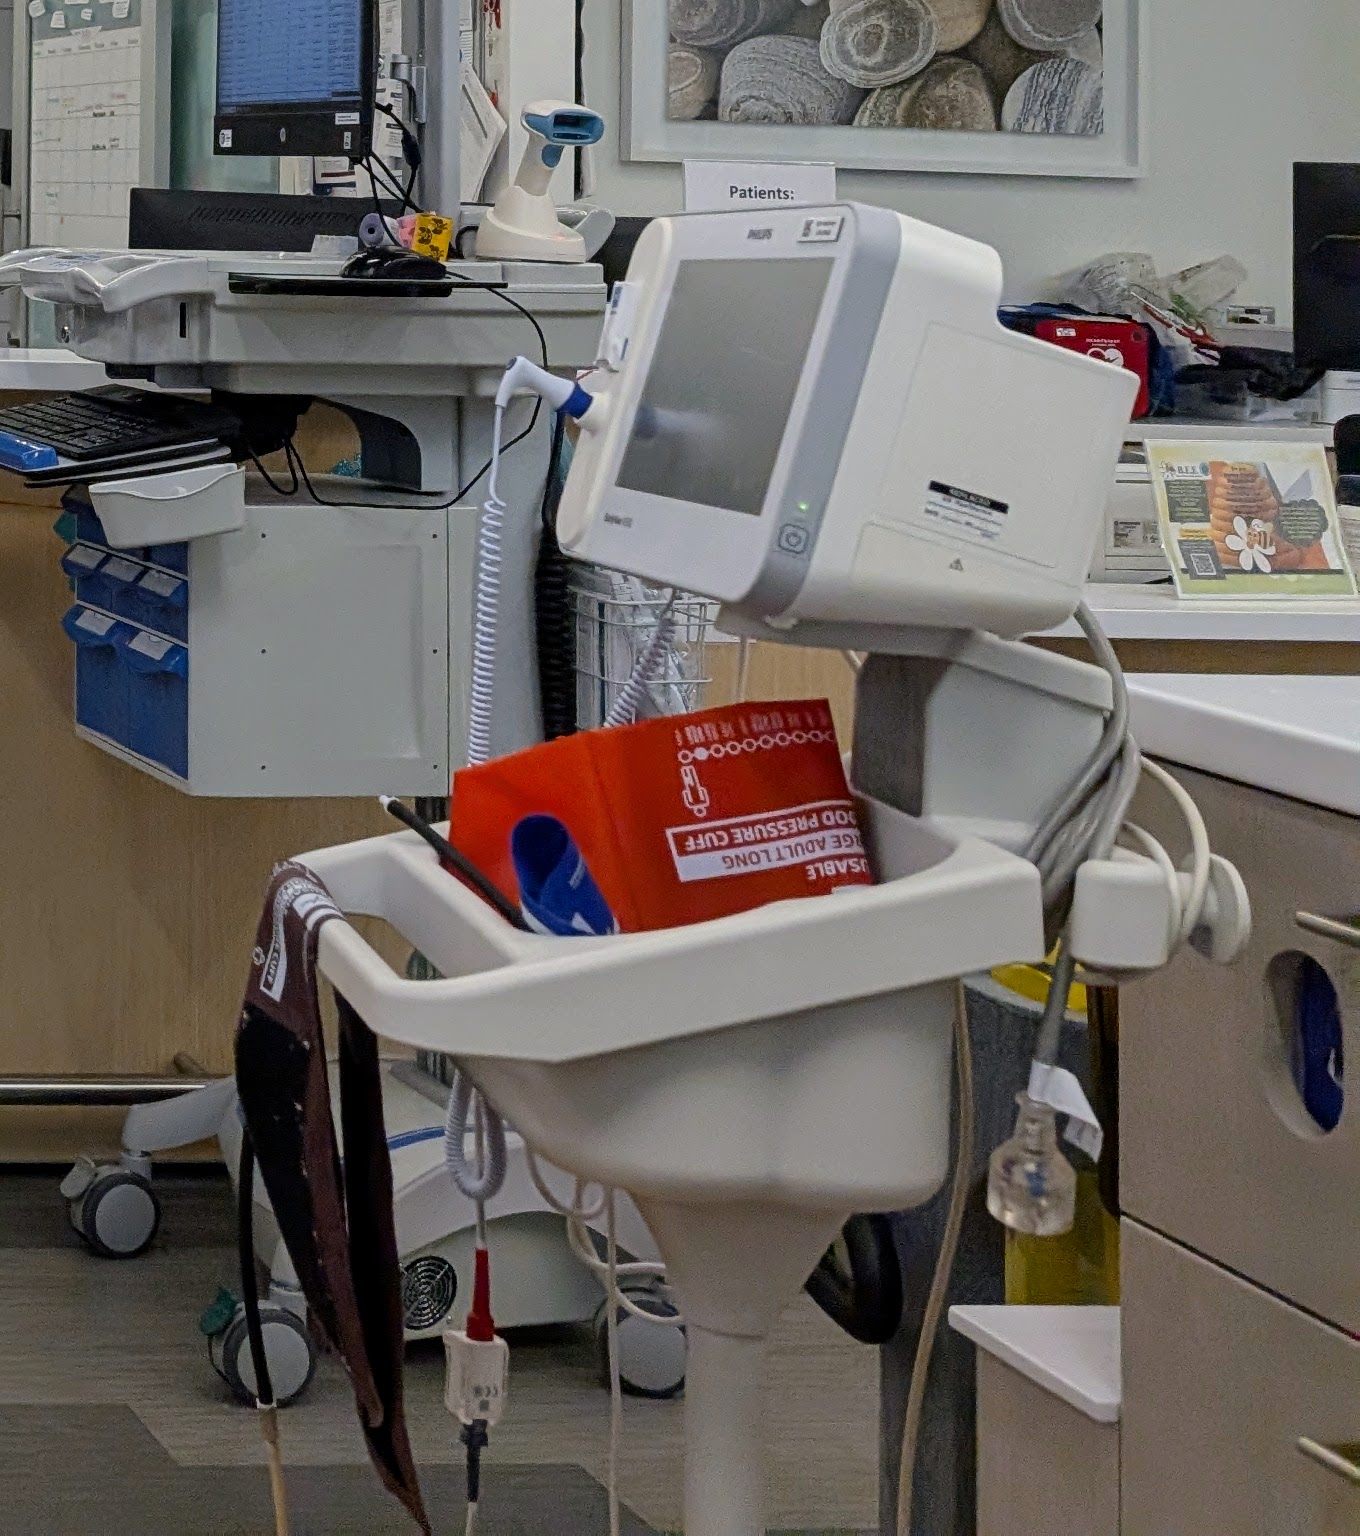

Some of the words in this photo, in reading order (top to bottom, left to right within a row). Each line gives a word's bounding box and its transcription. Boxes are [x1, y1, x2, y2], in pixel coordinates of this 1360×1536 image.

[729, 185, 795, 200] Patients:
[731, 812, 819, 844] PRESSURE
[685, 830, 729, 852] CUFF
[775, 836, 826, 862] ADULT
[722, 848, 772, 869] LONG
